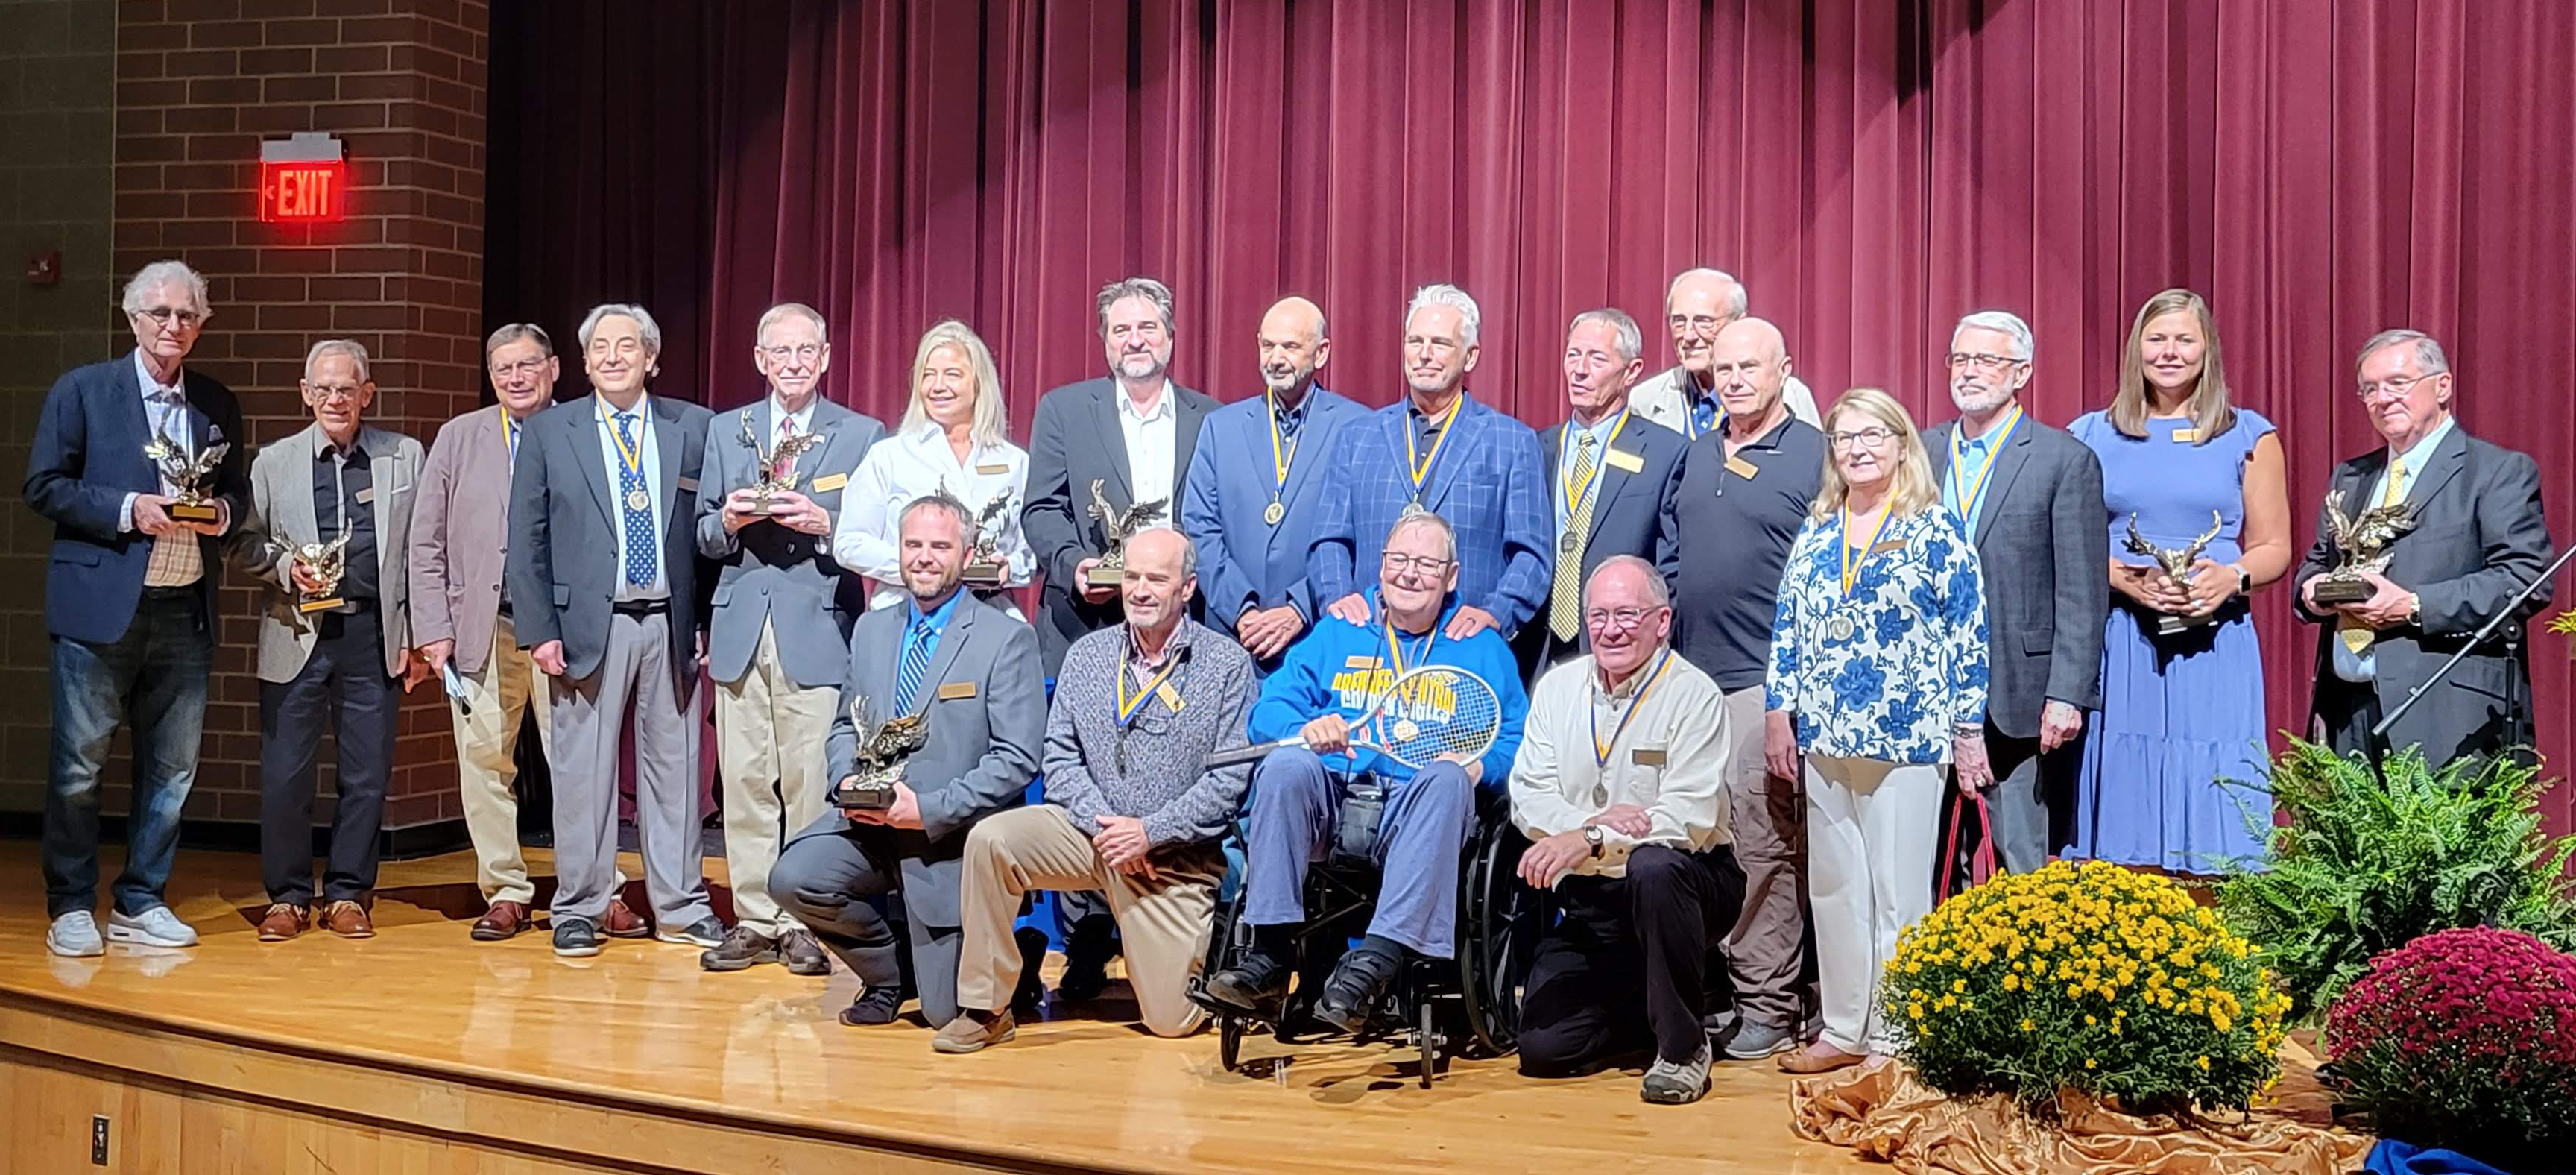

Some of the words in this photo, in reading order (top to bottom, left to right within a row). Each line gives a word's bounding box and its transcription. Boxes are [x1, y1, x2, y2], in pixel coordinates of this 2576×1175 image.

[277, 170, 333, 216] EXIT
[1341, 690, 1396, 716] GOLDN
[1401, 675, 1457, 716] NTRAL
